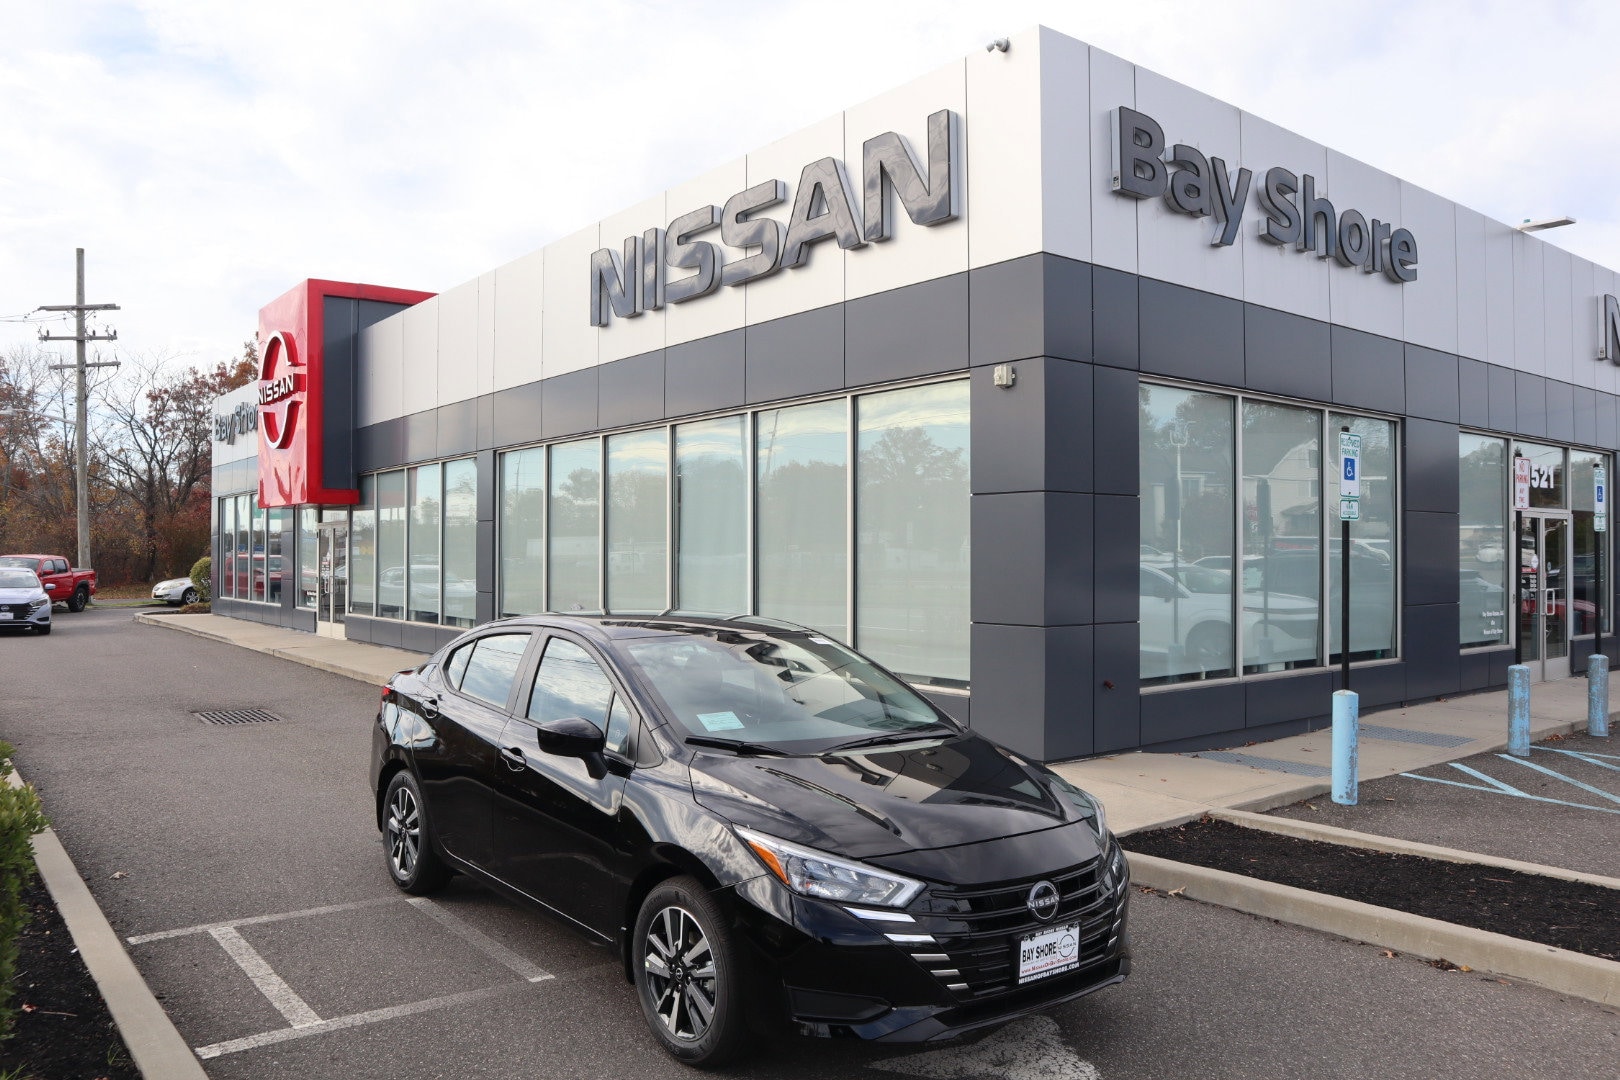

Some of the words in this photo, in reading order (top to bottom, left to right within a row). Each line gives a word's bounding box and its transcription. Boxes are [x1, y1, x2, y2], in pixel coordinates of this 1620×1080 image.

[1110, 106, 1252, 247] Bay
[1257, 166, 1418, 283] Shore
[590, 109, 960, 327] NISSAN
[259, 374, 294, 405] NISSAN
[214, 413, 236, 445] Bay
[234, 401, 258, 434] Shor
[1341, 448, 1359, 457] PARKING
[1529, 463, 1555, 489] 521
[1027, 895, 1060, 908] NISSAN
[1022, 947, 1035, 963] BAY
[1035, 941, 1057, 960] SHORE
